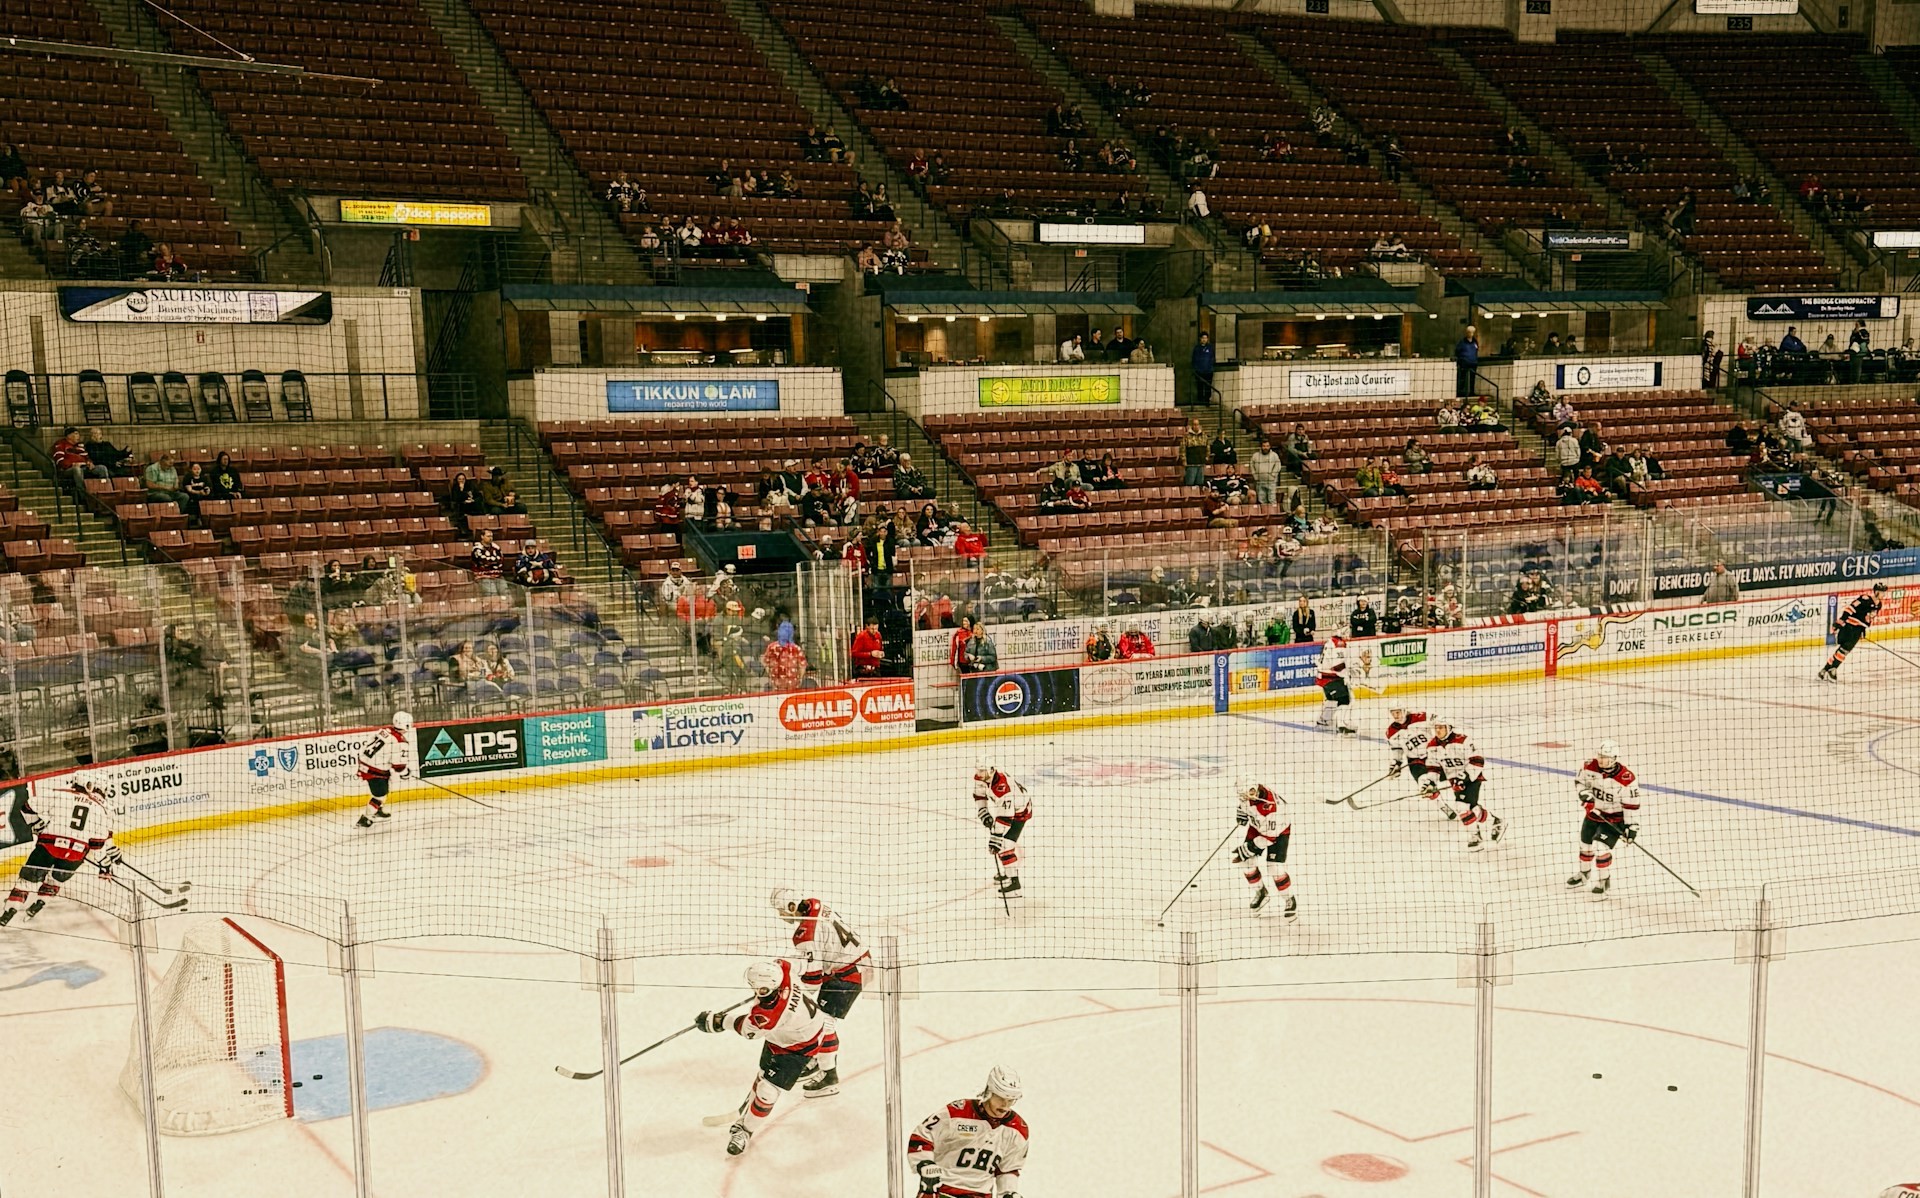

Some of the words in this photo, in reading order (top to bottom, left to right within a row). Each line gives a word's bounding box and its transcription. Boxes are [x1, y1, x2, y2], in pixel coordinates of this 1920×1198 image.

[1308, 1, 1328, 12] 233
[1529, 2, 1548, 13] 234
[1729, 18, 1751, 29] 235
[159, 304, 195, 313] Business
[197, 304, 237, 314] Machines
[1305, 374, 1322, 387] The
[1323, 374, 1343, 388] Post
[1344, 374, 1360, 385] and
[1362, 373, 1396, 385] Courier
[632, 385, 700, 400] TIKKUN
[664, 400, 695, 409] repairing
[696, 400, 708, 408] the
[709, 400, 727, 408] world
[1842, 554, 1881, 577] CHS
[1609, 578, 1639, 595] DON'T
[1659, 572, 1702, 591] BENCHED
[1753, 566, 1777, 582] DAYS.
[1779, 564, 1795, 579] FLY
[1795, 561, 1837, 578] NONSTOP.
[1654, 610, 1737, 630] NUCOR
[1748, 613, 1790, 627] BROOKS
[1667, 630, 1723, 644] BERKELEY
[1007, 641, 1043, 655] RELIABLE
[1044, 638, 1080, 651] INTERNET
[1448, 648, 1496, 660] REMODELING
[1498, 642, 1544, 654] REIMAGINED
[1617, 640, 1646, 652] ZONE
[1278, 654, 1310, 667] CELEBRATE
[1145, 670, 1163, 680] YEARS
[1164, 668, 1175, 678] AND
[1176, 666, 1203, 678] COUNTING
[1242, 674, 1258, 682] BUD
[1134, 684, 1151, 695] LOCAL
[1152, 681, 1182, 693] INSURANCE
[1183, 678, 1212, 689] SOLUTIONS
[1238, 681, 1261, 690] LIGHT
[997, 692, 1022, 701] PEPSI
[665, 705, 698, 716] South
[700, 702, 744, 713] Carolina
[785, 699, 853, 722] AMALIE
[665, 712, 754, 730] Education
[881, 713, 902, 721] MOTOR
[540, 716, 594, 733] Respond.
[802, 721, 825, 729] MOTOR
[464, 729, 518, 757] IPS
[542, 732, 592, 746] Rethink.
[667, 729, 745, 748] Lottery
[464, 754, 487, 763] POWER
[543, 747, 592, 761] Resolve.
[125, 767, 142, 778] Car
[145, 763, 179, 775] Dealer.
[121, 773, 183, 796] SUBARU
[251, 778, 287, 795] Federal
[290, 774, 340, 790] Employee
[1002, 800, 1012, 810] 47
[69, 804, 90, 832] 9
[1268, 821, 1276, 831] 10
[957, 1122, 978, 1133] CREWS
